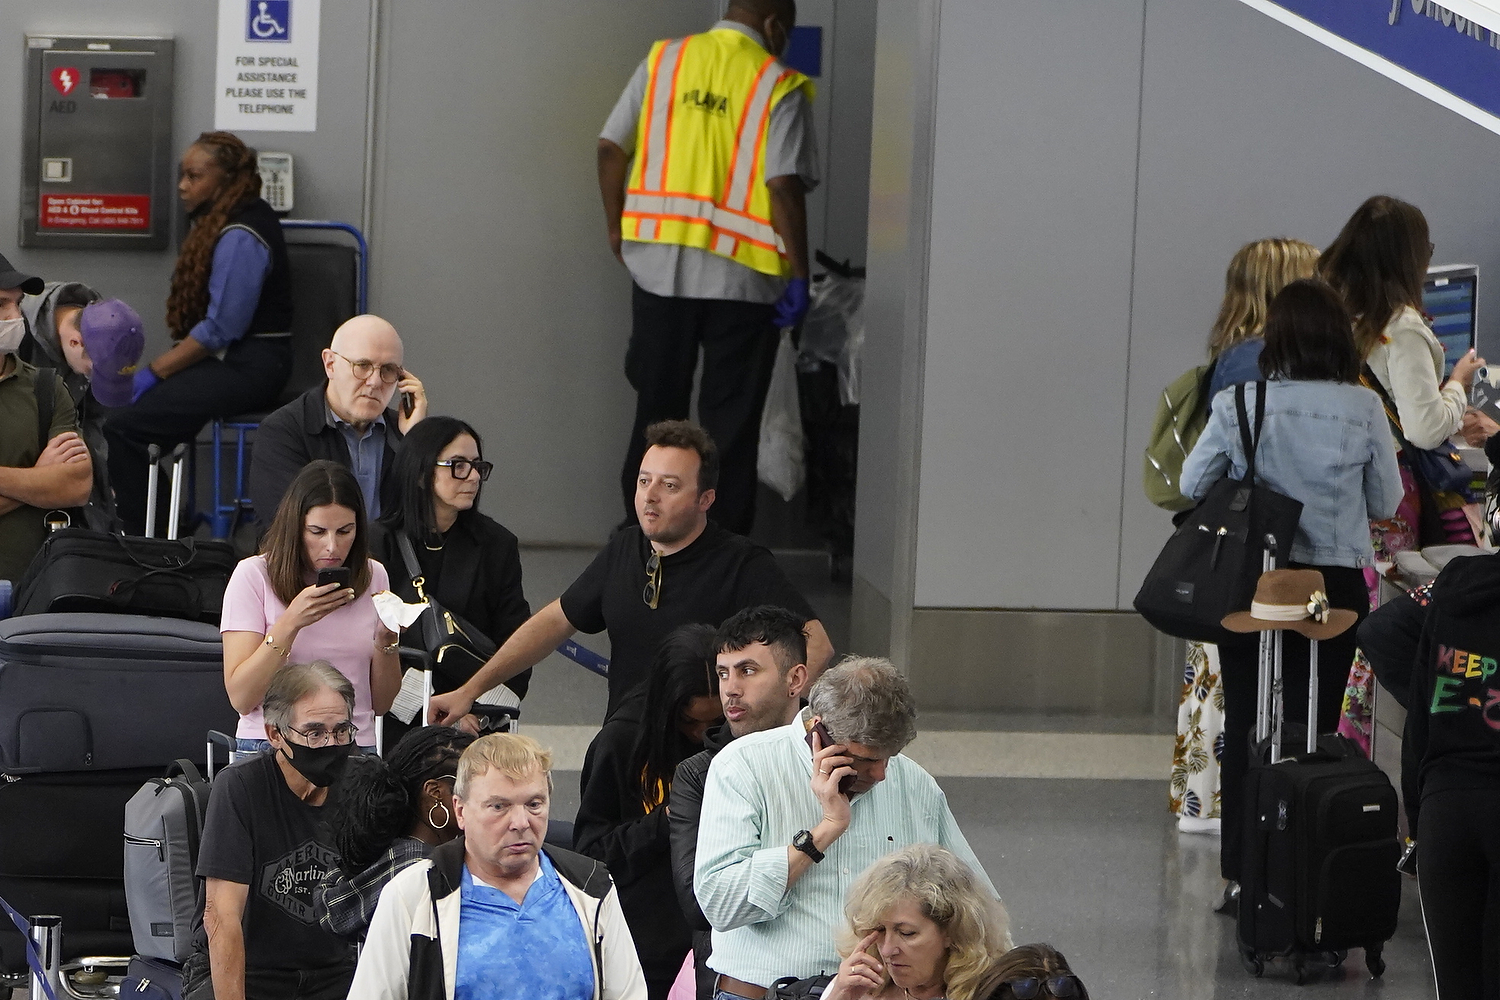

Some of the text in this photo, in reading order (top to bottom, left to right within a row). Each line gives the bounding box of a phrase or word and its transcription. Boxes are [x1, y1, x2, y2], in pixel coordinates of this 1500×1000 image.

[235, 56, 299, 67] FOR SPECIAL
[237, 72, 297, 82] ASSISTANCE
[225, 87, 306, 98] PLEASE USE THE
[50, 101, 77, 114] AED
[238, 103, 294, 114] TELEPHONE
[1437, 643, 1498, 682] KEEP
